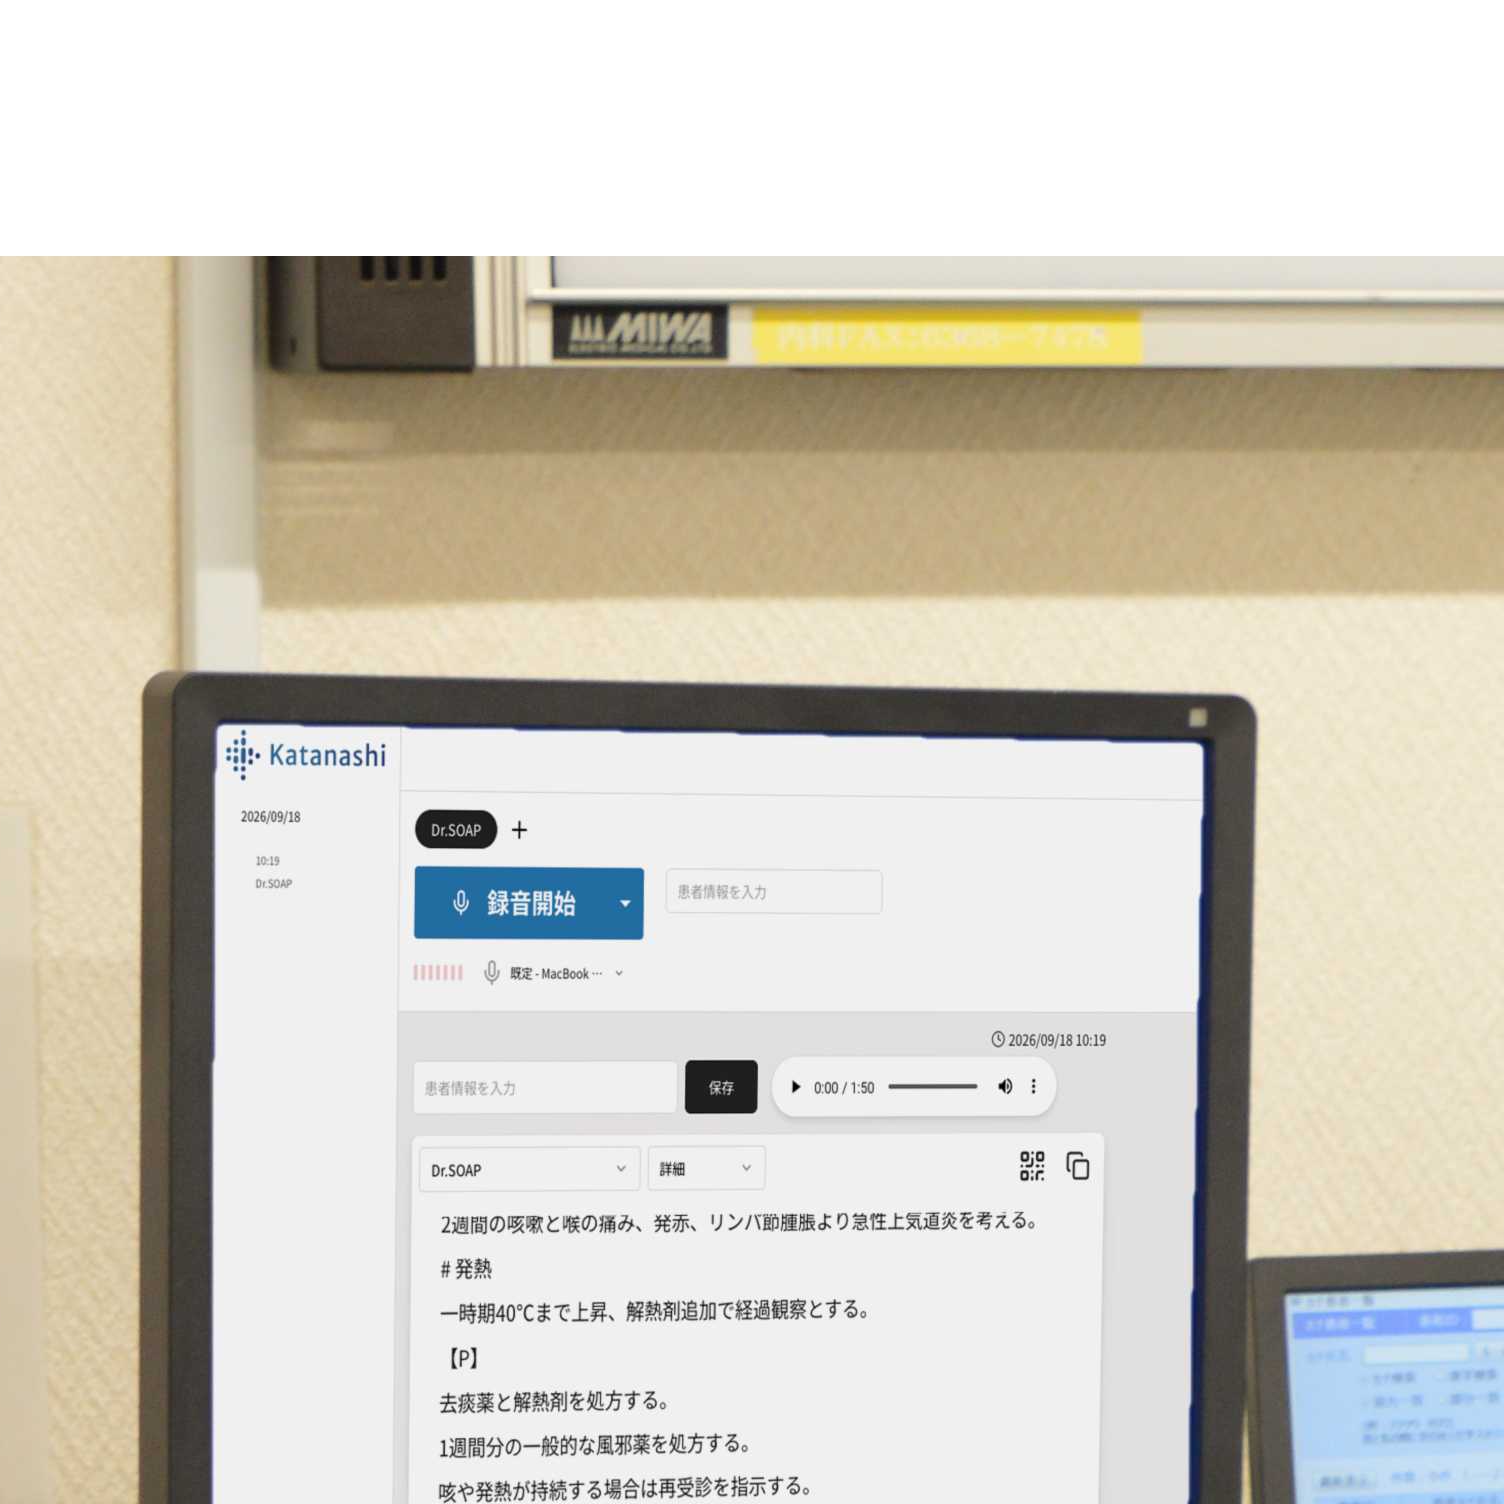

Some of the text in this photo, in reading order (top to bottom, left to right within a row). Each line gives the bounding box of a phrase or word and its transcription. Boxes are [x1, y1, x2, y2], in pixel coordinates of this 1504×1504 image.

[607, 312, 713, 344] MIWA
[271, 743, 385, 766] Katanashi
[241, 810, 301, 824] 2026/09/18
[432, 824, 481, 837] Dr.SOAP
[256, 856, 280, 866] 10:19
[256, 879, 292, 888] Dr.SOAP
[678, 884, 766, 900] 患者情報を入力
[488, 890, 575, 920] 録音開始
[511, 967, 532, 980] 既定
[542, 968, 589, 979] MacBook
[1009, 1033, 1106, 1048] 2026/09/18 10:19
[425, 1081, 515, 1096] 患者情報を入力
[709, 1080, 734, 1095] 保存
[815, 1082, 838, 1094] 0:00
[852, 1082, 874, 1094] 1:50
[432, 1164, 481, 1177] Dr.SOAP
[660, 1162, 685, 1176] 詳細
[441, 1258, 492, 1279] # 発熱
[440, 1299, 866, 1324] 一時期40℃まで上昇、解熱剤追加で経過観察とする。
[440, 1390, 666, 1413] 去痰薬と解熱剤を処方する。
[440, 1433, 748, 1458] 1週間分の一般的な風邪薬を処方する。
[439, 1476, 809, 1503] 咳や発熱が持続する場合は再受診を指示する。
